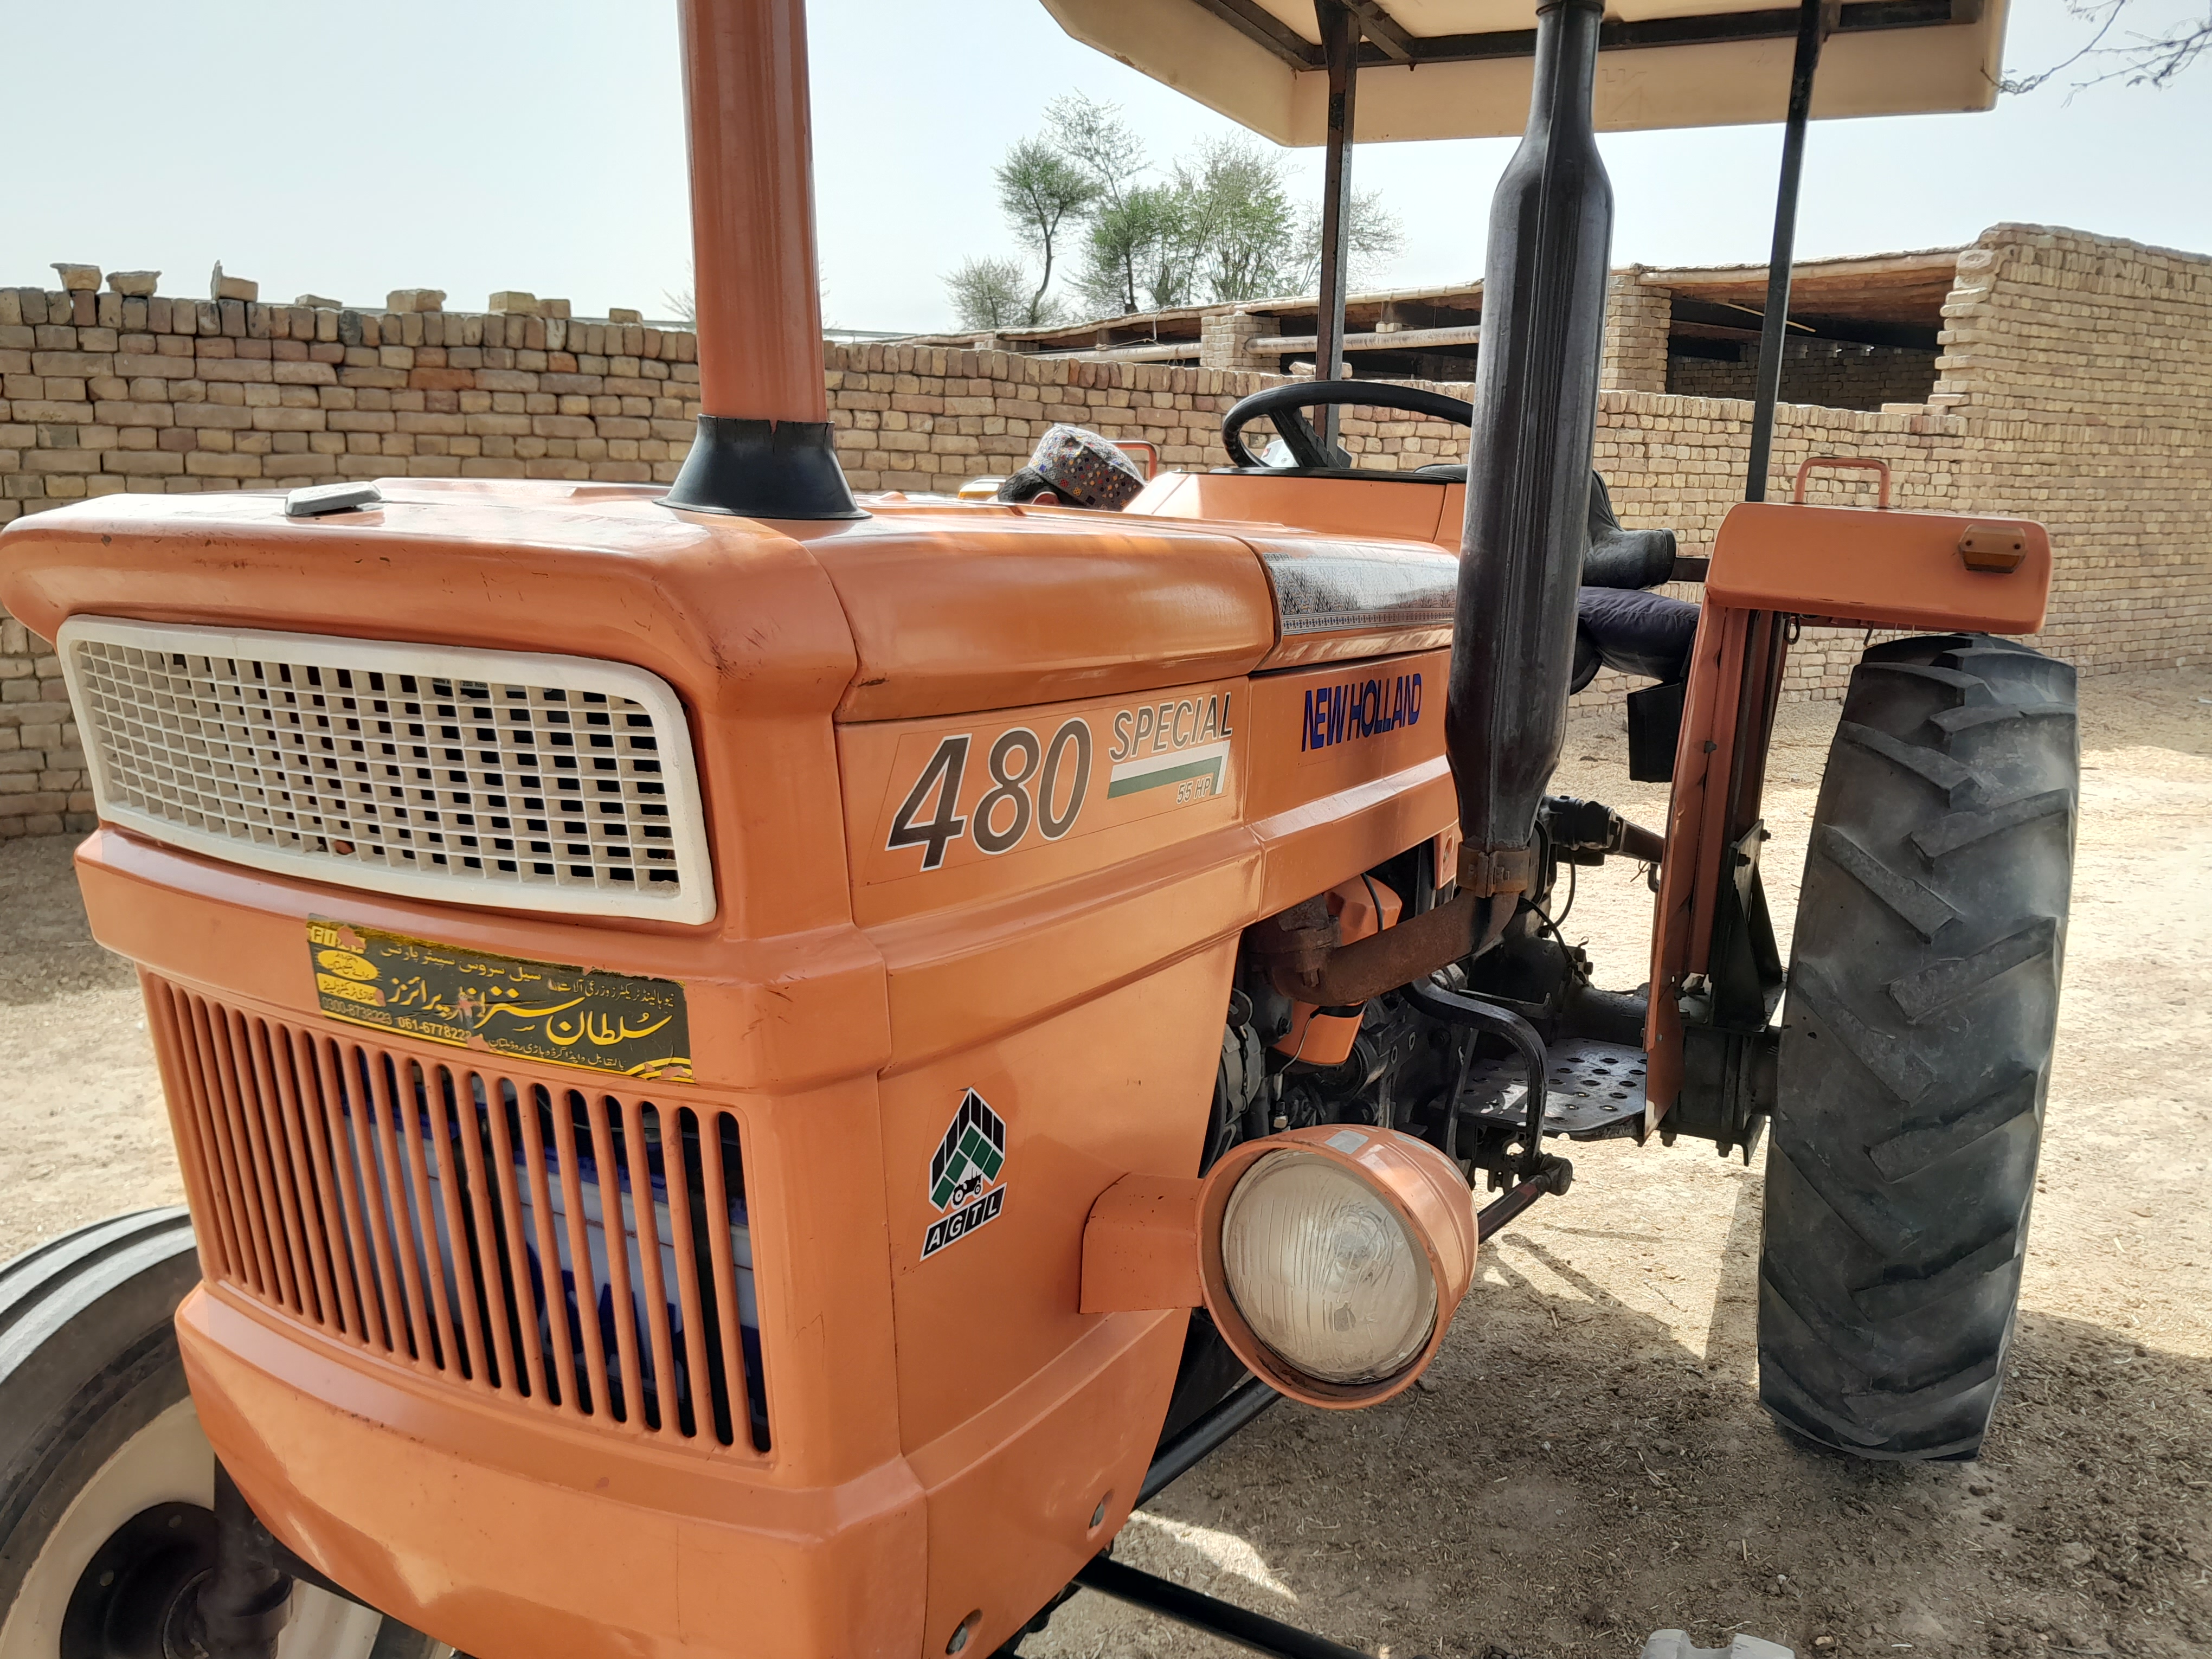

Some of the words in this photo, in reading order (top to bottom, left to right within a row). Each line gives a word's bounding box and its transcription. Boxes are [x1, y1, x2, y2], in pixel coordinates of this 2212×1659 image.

[1108, 692, 1233, 762] SPECIAL
[1302, 684, 1348, 753] NEW
[1347, 673, 1422, 742] HOLLAND
[885, 717, 1092, 872] 480
[1176, 780, 1194, 804] 55
[1193, 776, 1211, 800] HP
[459, 960, 505, 977] سروس
[510, 967, 542, 982] سیل
[927, 1194, 998, 1251] AGTL
